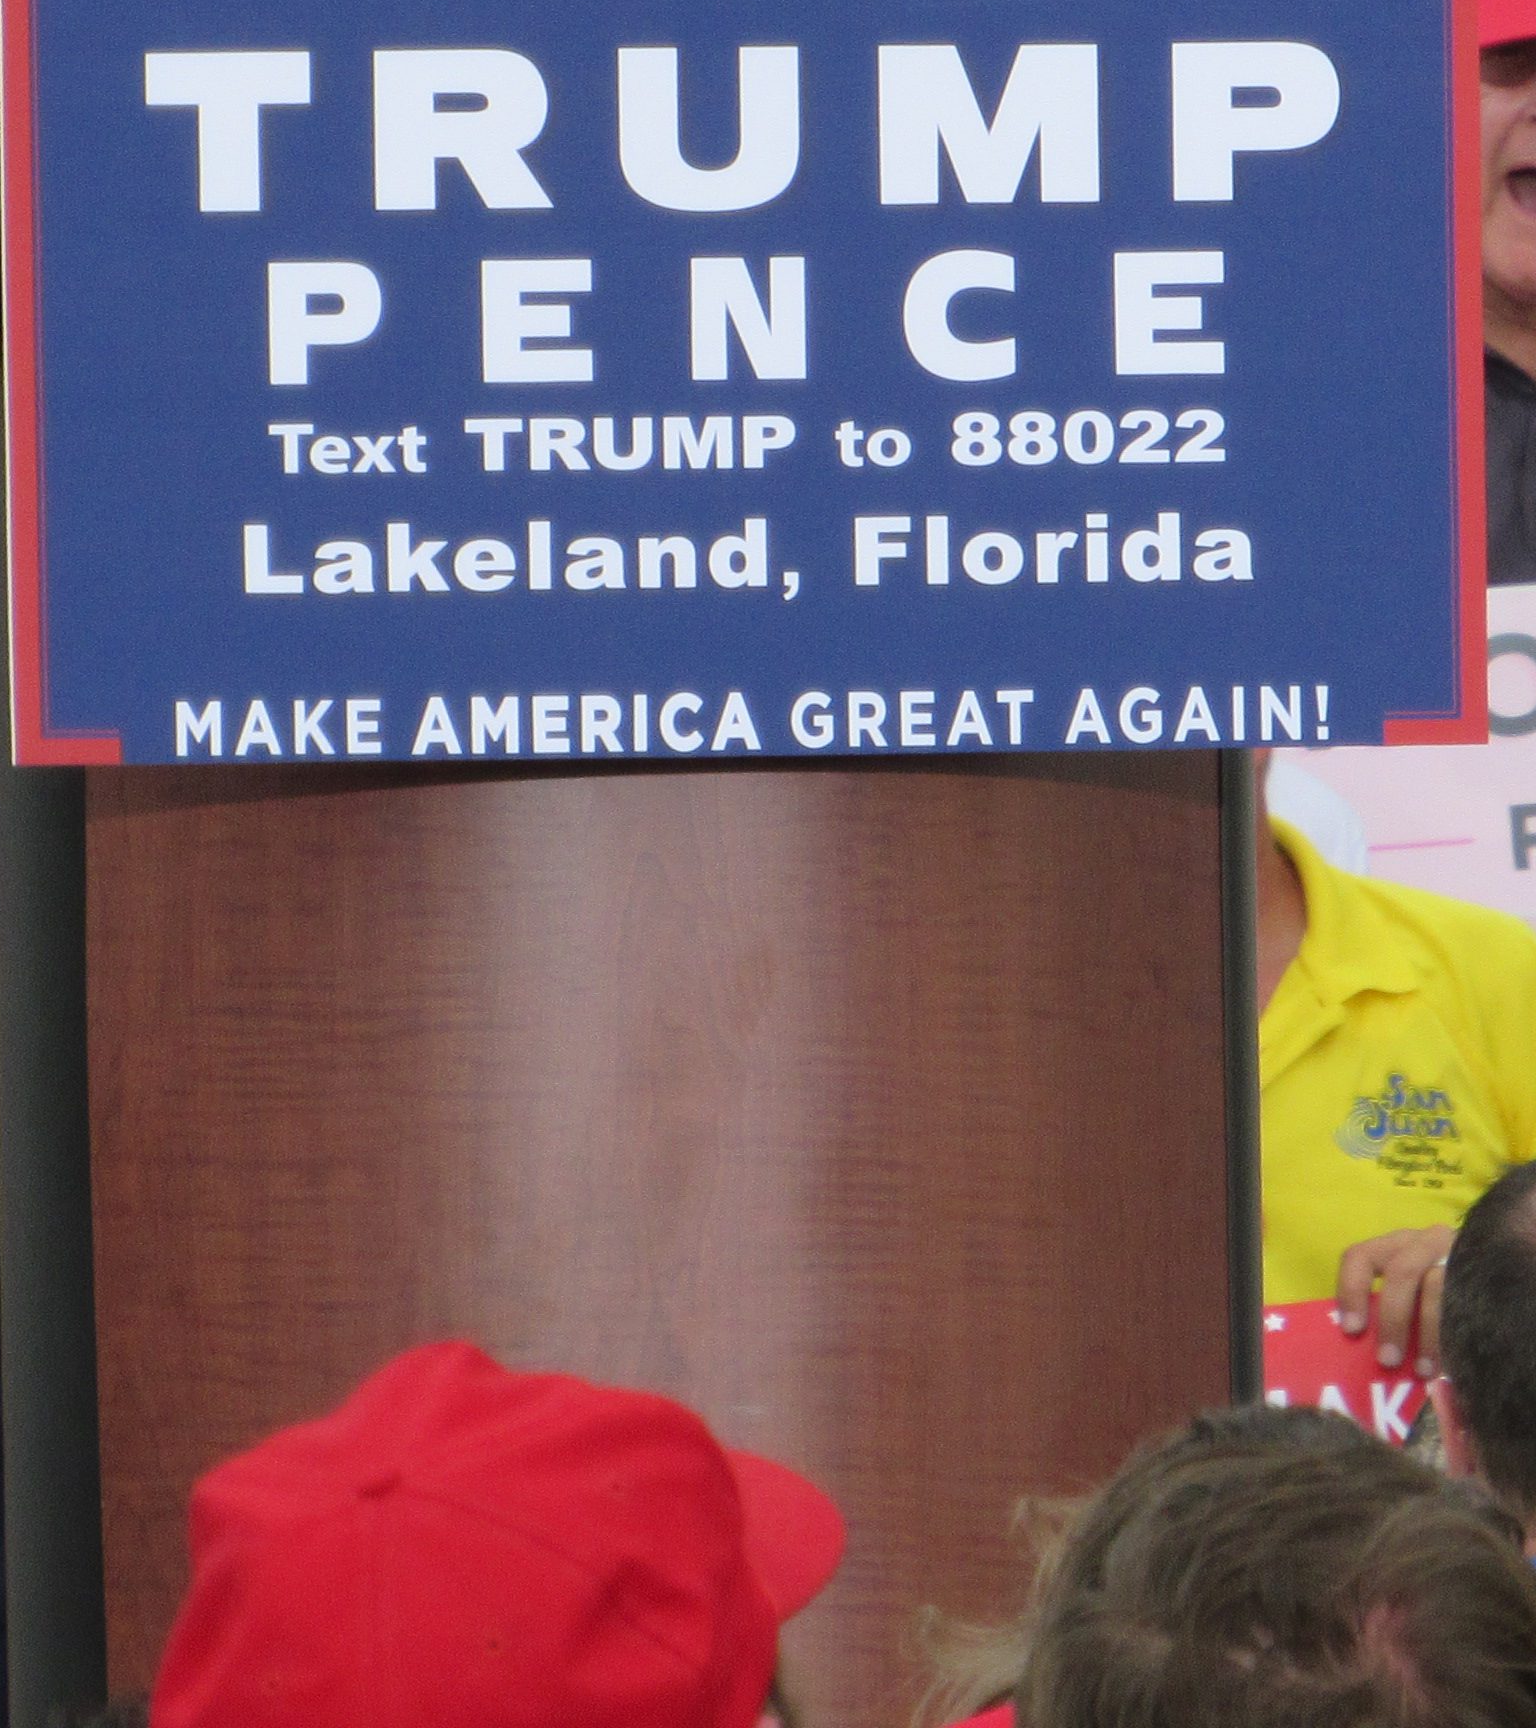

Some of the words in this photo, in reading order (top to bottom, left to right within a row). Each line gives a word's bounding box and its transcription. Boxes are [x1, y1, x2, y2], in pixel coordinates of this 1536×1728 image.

[144, 40, 1342, 214] TRUMP
[266, 248, 1227, 386] PENCE
[267, 422, 428, 475] Text
[463, 415, 797, 473] TRUMP
[834, 419, 912, 469] to
[950, 409, 1227, 467] 88022
[242, 518, 800, 601] Lakeland,
[852, 512, 1254, 587] Florida
[174, 697, 383, 759] MAKE
[411, 690, 763, 757] AMERICA
[789, 689, 1035, 750] GREAT
[1064, 683, 1332, 746] AGAIN!
[1381, 1072, 1455, 1113] San
